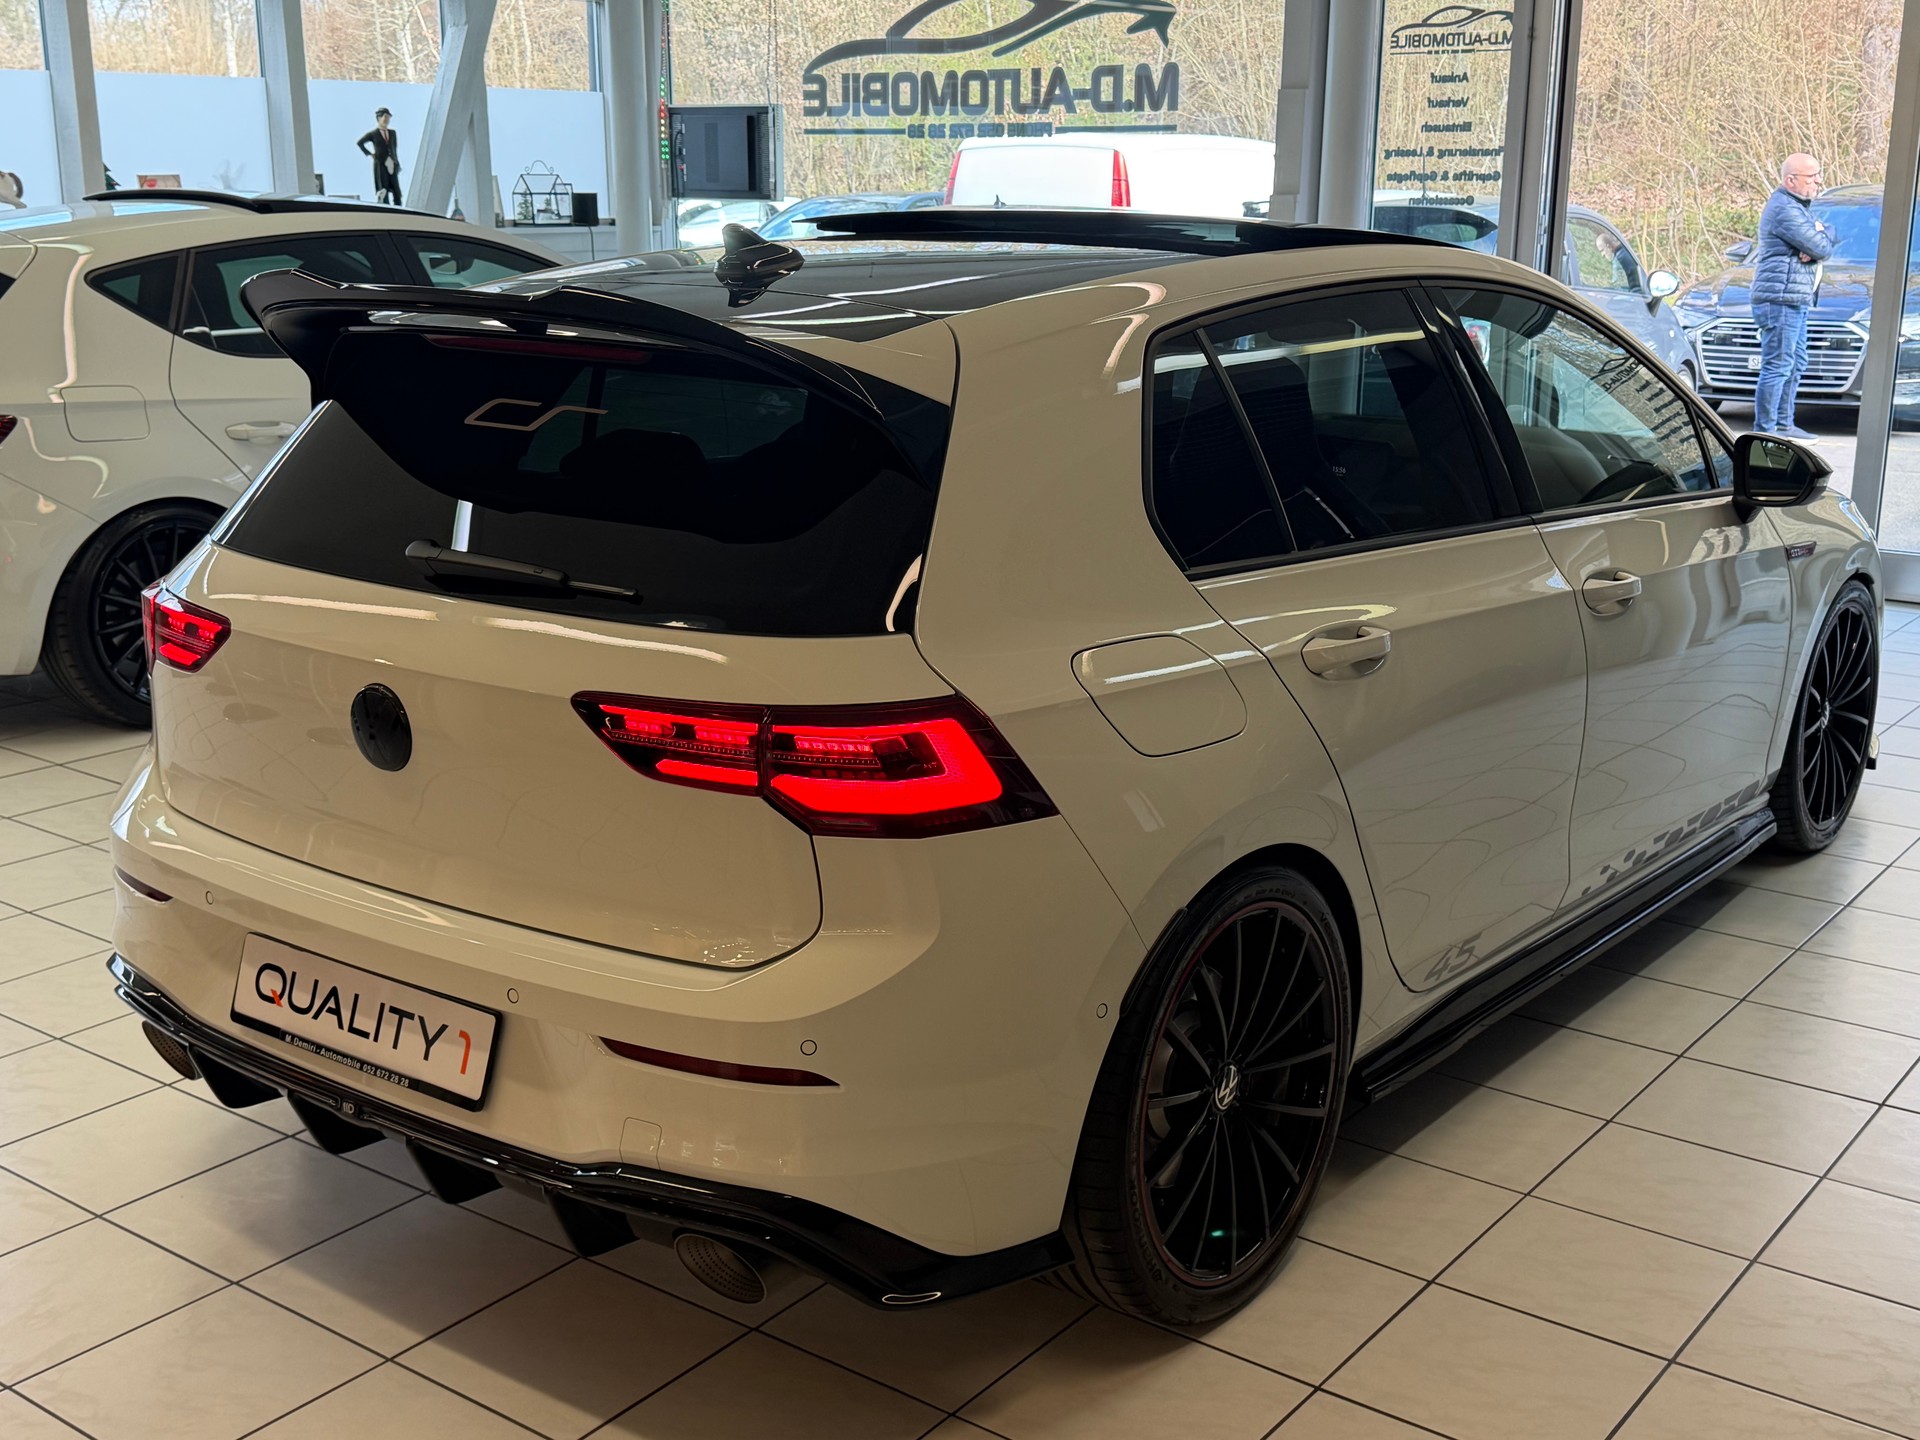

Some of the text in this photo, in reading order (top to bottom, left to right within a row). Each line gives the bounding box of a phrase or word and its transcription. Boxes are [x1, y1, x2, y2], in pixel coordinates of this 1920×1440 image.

[320, 1047, 361, 1069] Automobile
[363, 1063, 376, 1076] 052
[376, 1068, 389, 1080] 672
[390, 1072, 399, 1083] 28
[400, 1077, 410, 1088] 28
